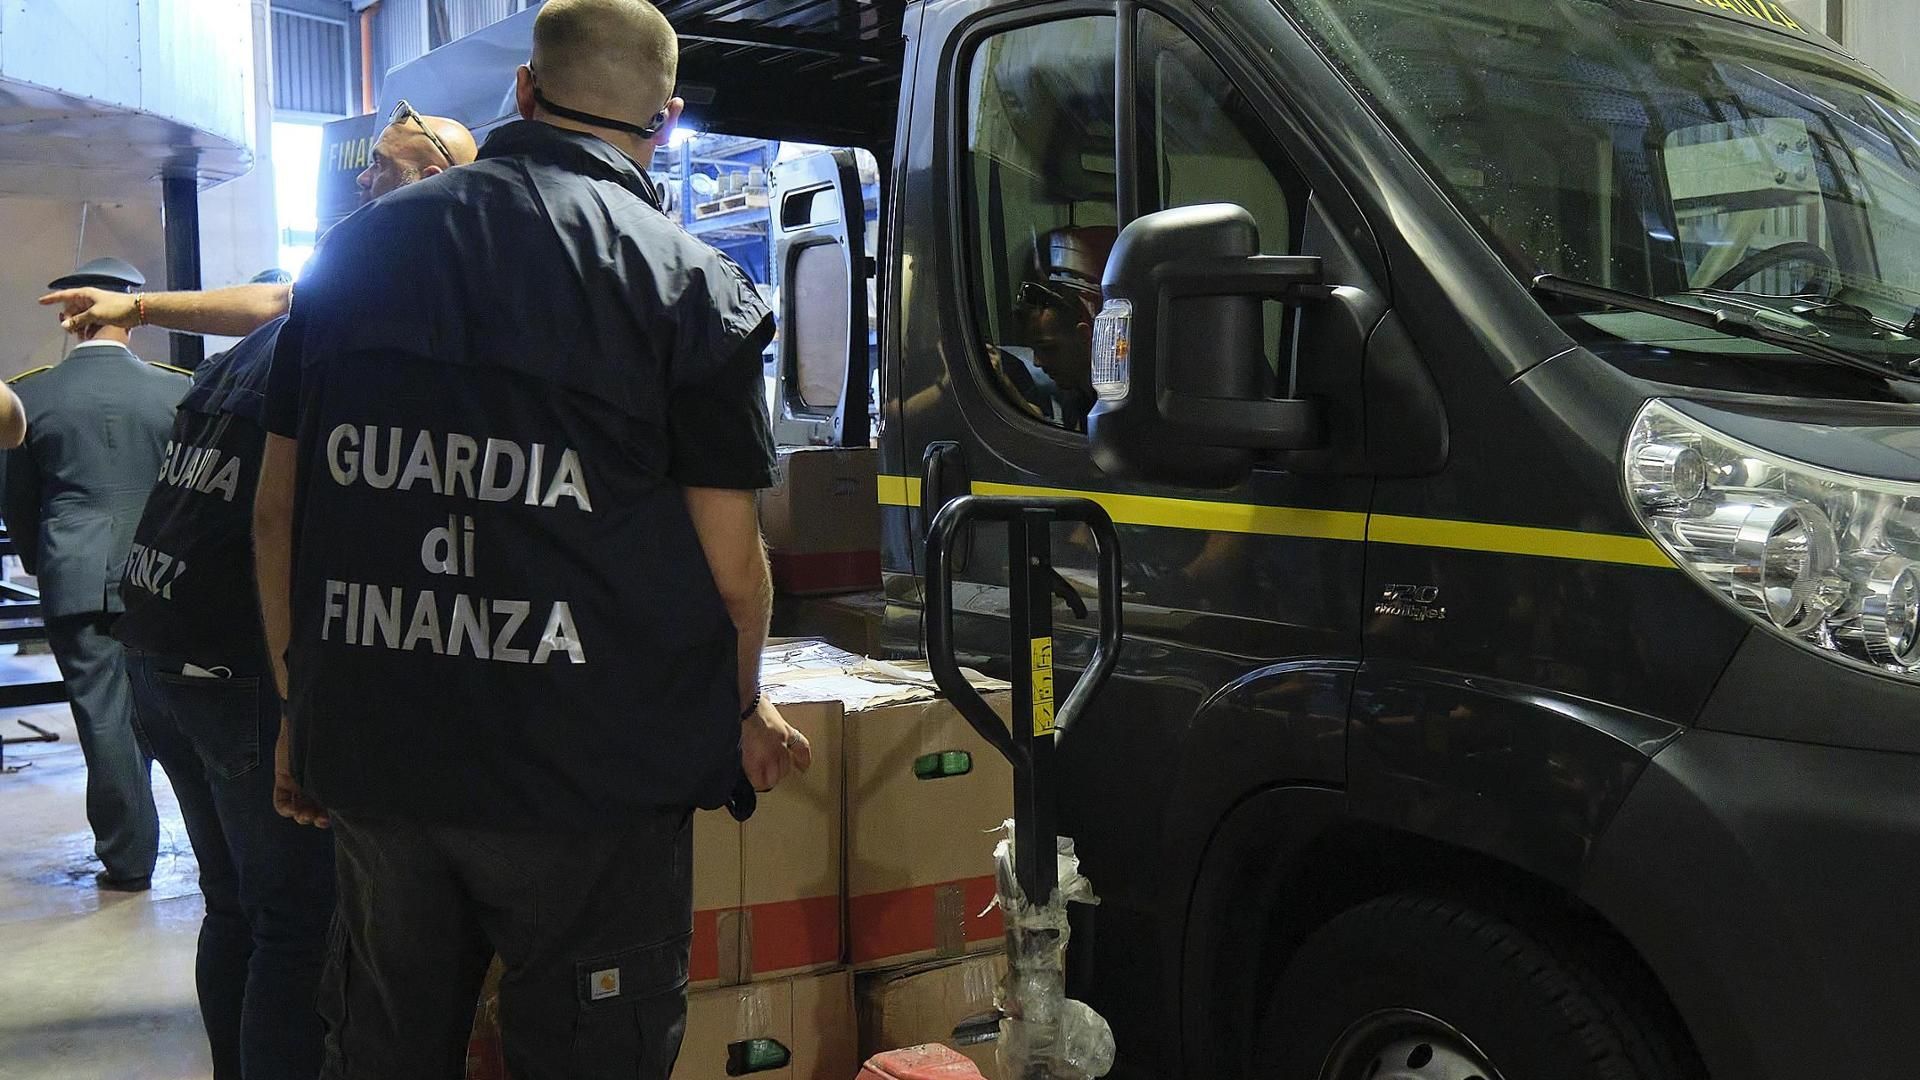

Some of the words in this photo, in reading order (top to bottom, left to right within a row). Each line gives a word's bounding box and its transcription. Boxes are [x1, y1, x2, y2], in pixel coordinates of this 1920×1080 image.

[1695, 0, 1809, 35] ANZA
[327, 424, 592, 512] GUARDIA
[421, 514, 475, 577] di
[321, 580, 586, 664] FINANZA
